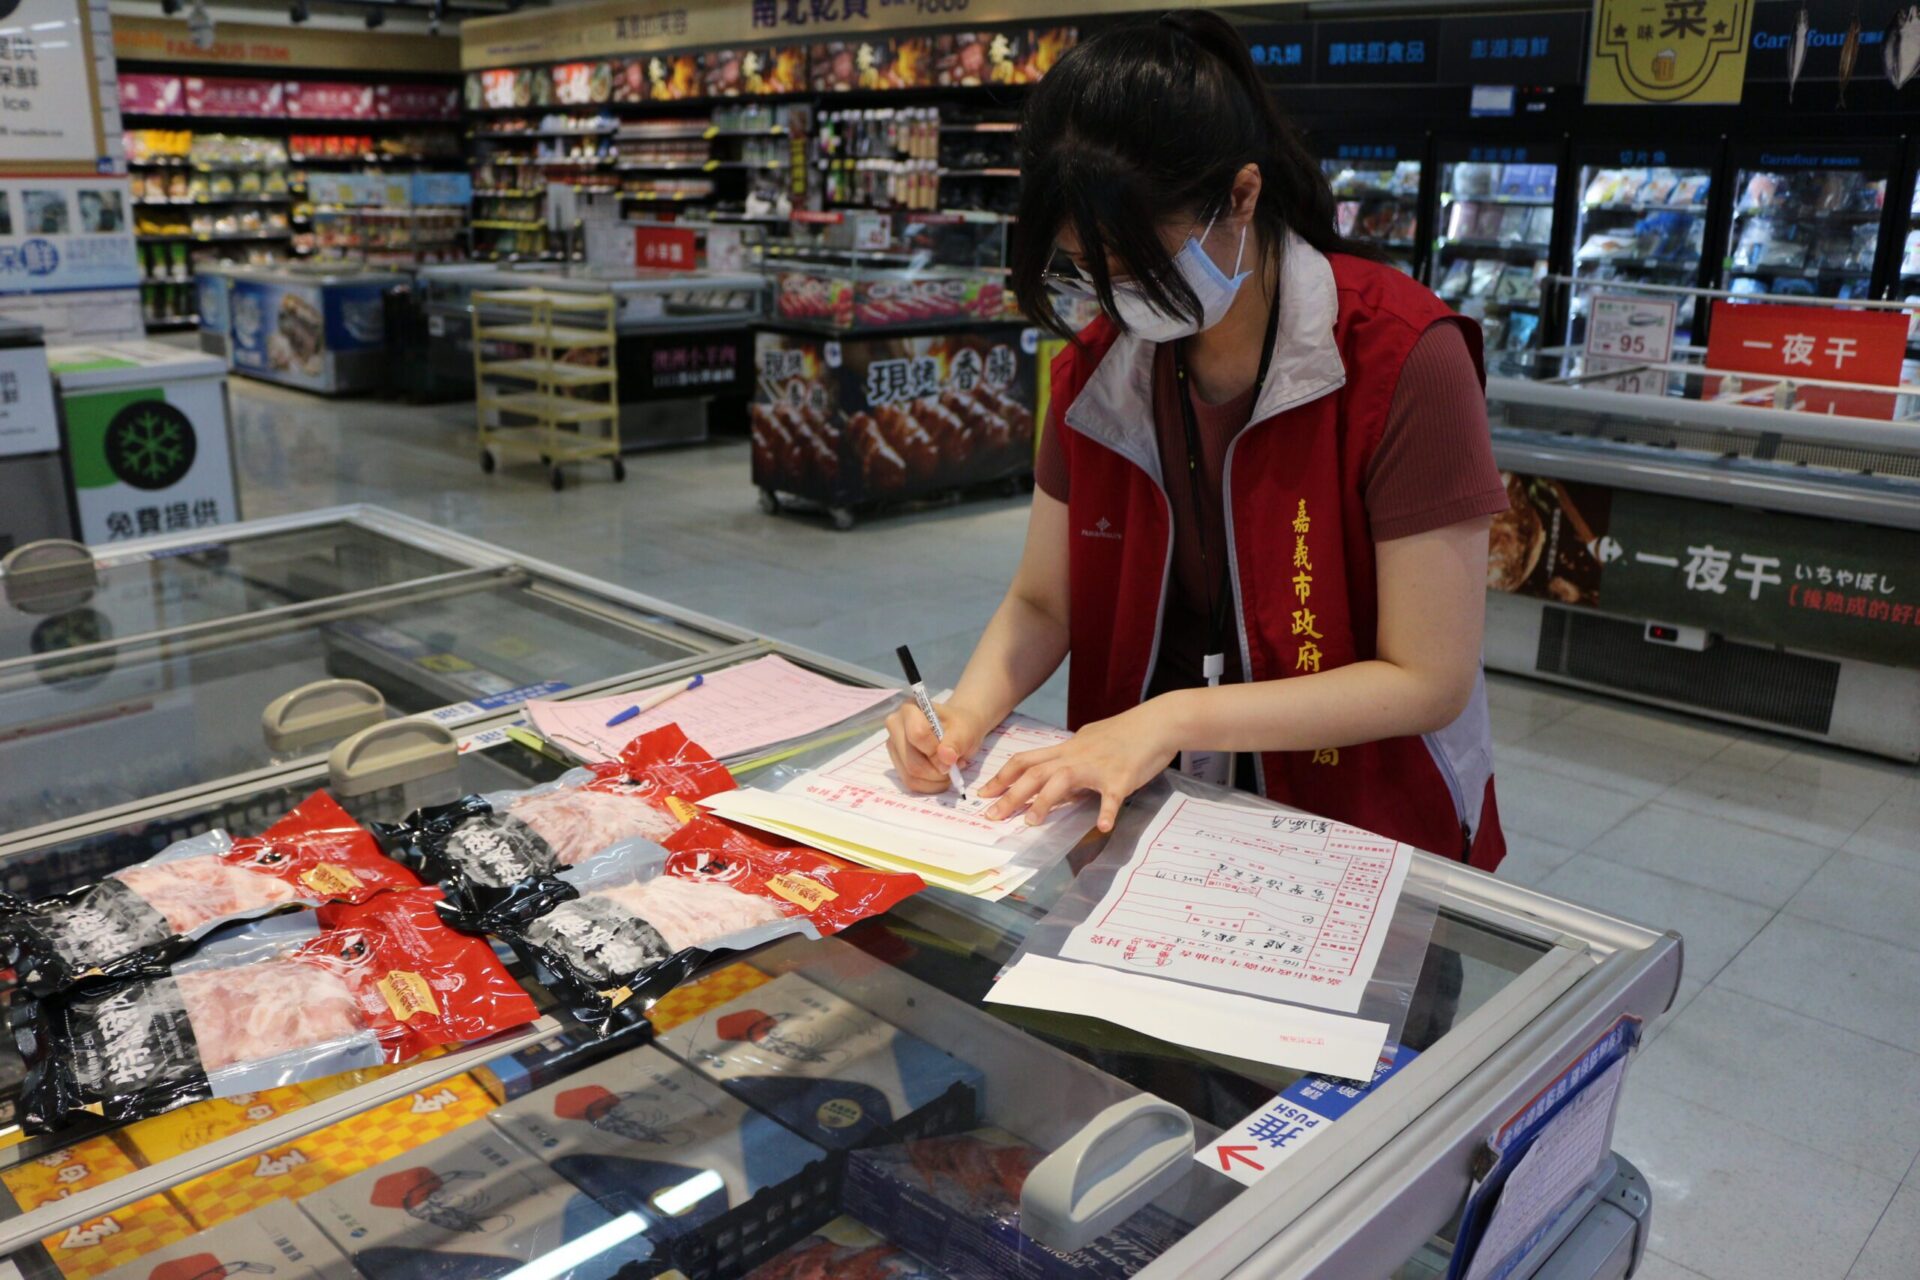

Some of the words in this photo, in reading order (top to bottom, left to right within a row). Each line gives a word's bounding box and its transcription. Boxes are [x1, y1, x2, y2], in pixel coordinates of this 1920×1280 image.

[1329, 41, 1425, 65] 調味即食品
[1620, 335, 1646, 354] 95
[1743, 334, 1857, 368] 一夜干
[106, 499, 220, 541] 免費提供
[1635, 545, 1781, 600] 一夜干
[1247, 1112, 1305, 1149] 推
[1272, 1102, 1320, 1129] PUSH
